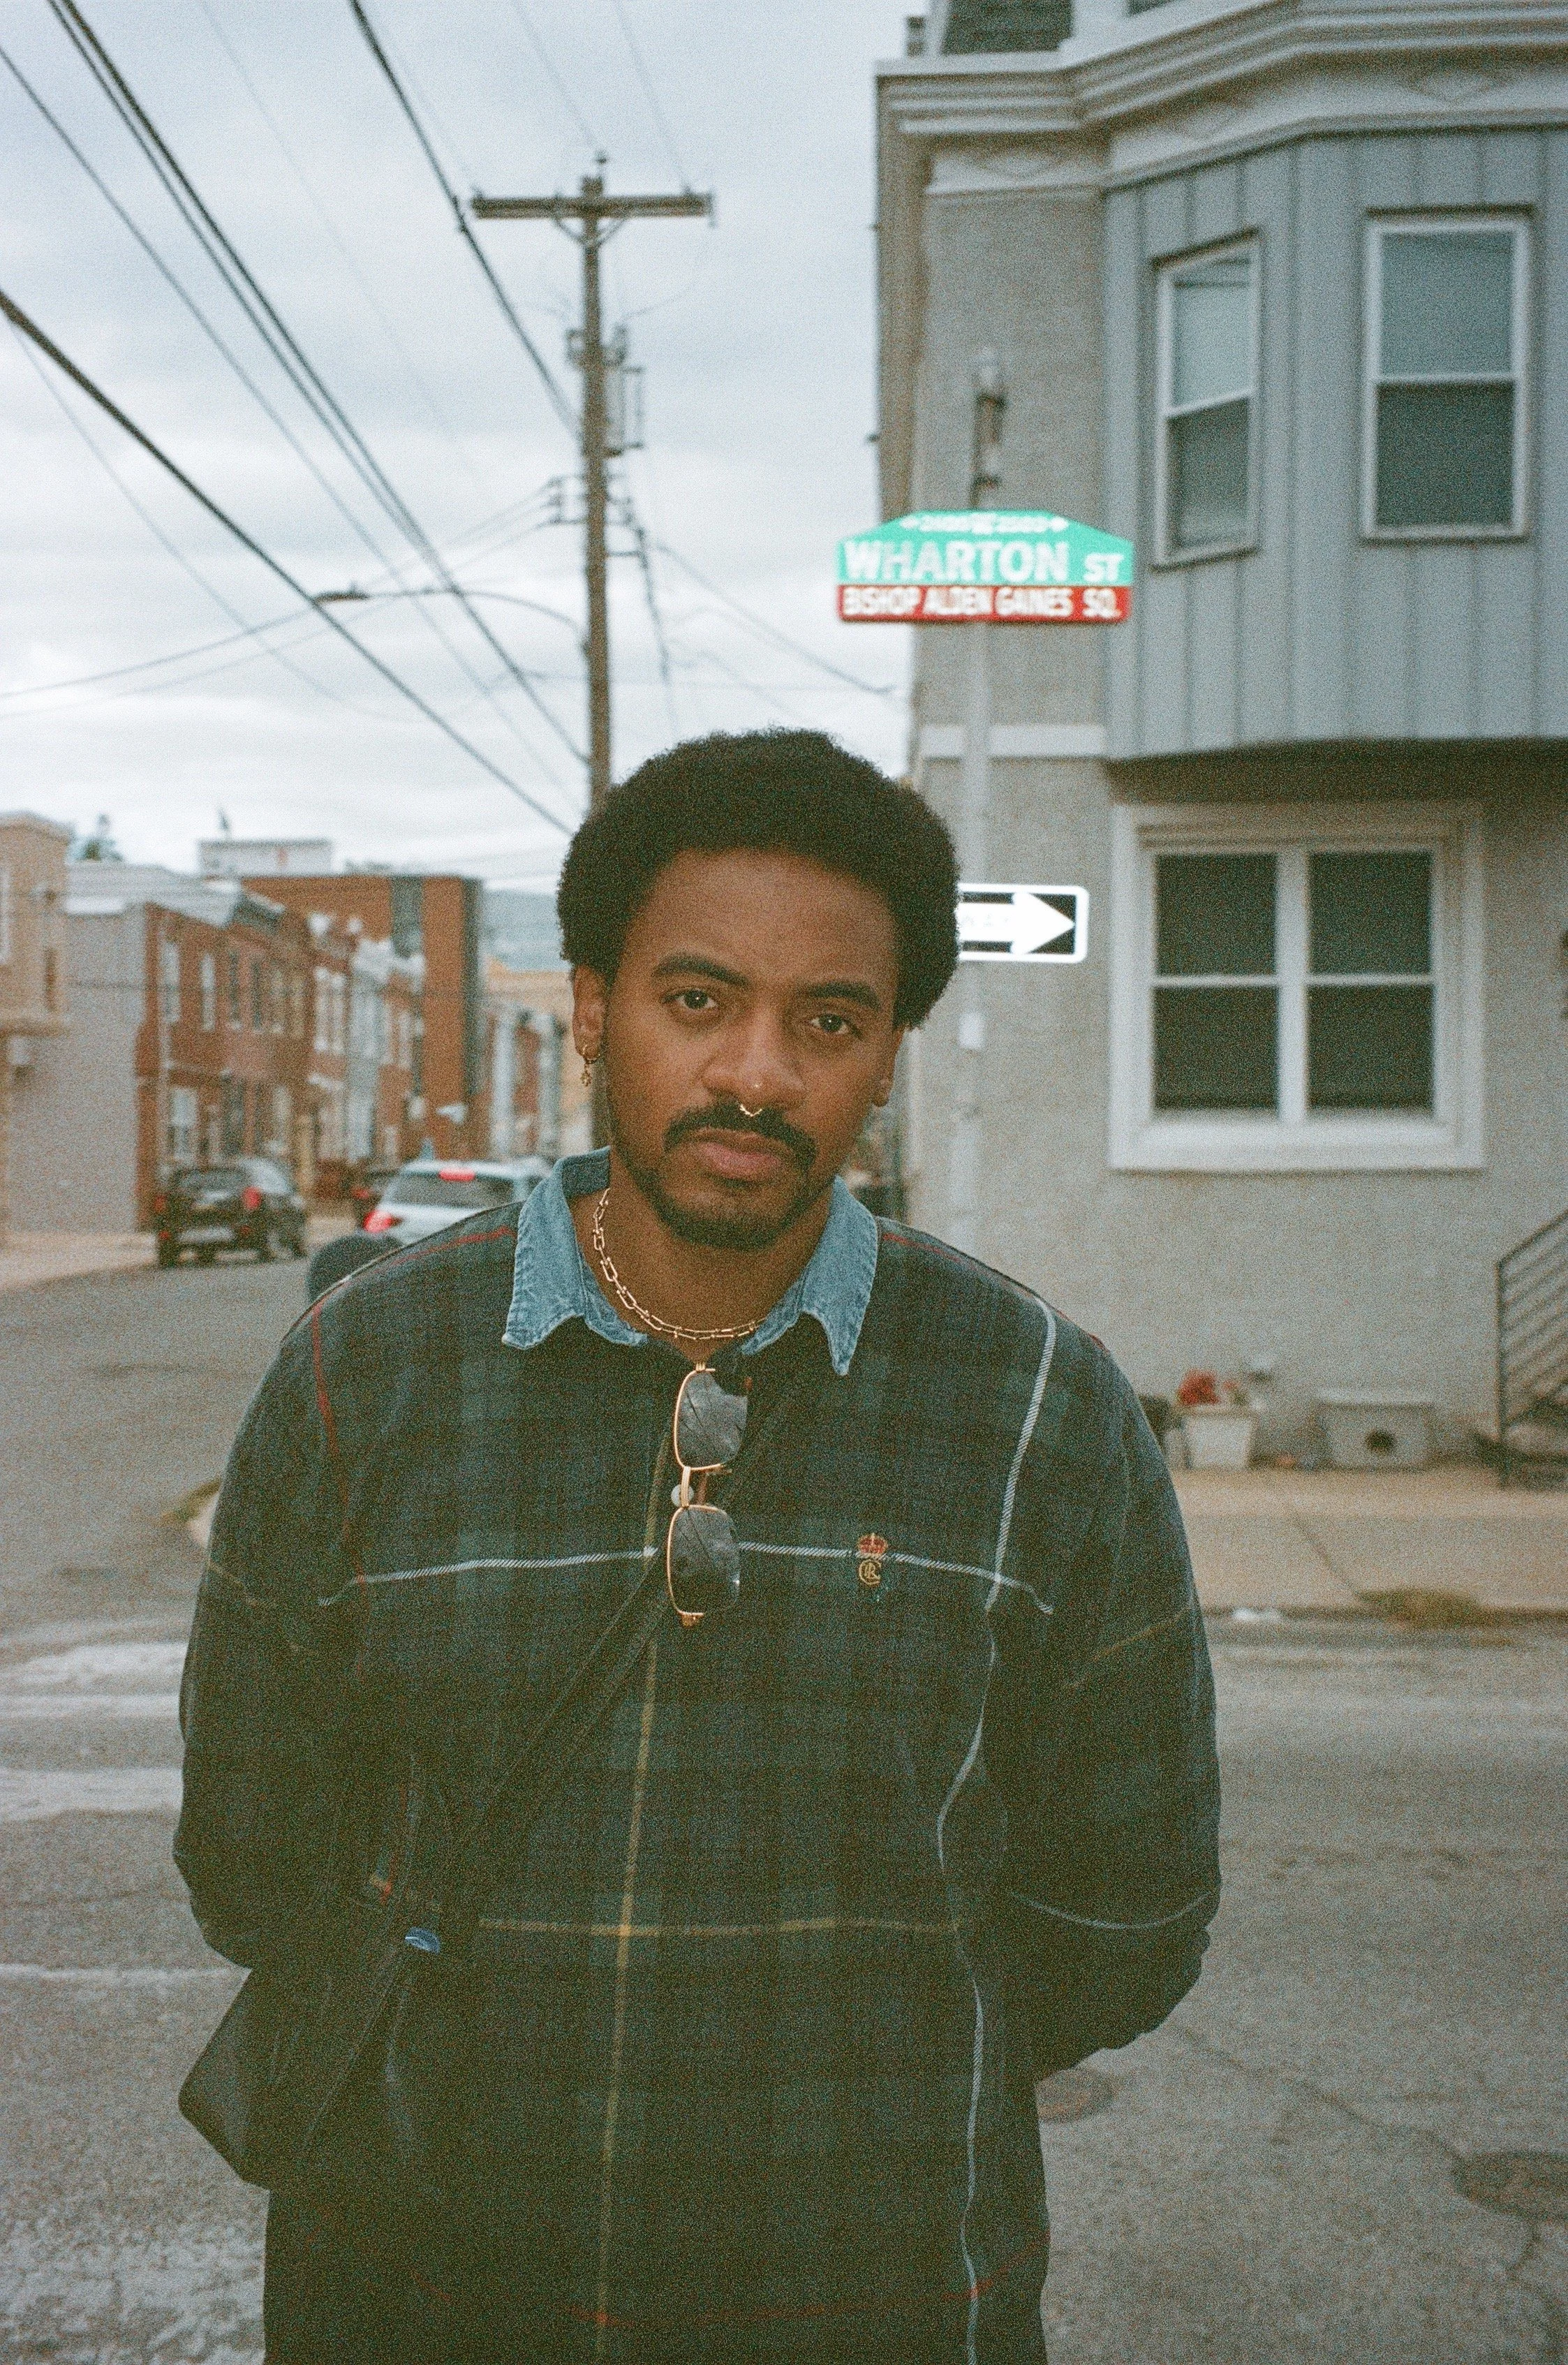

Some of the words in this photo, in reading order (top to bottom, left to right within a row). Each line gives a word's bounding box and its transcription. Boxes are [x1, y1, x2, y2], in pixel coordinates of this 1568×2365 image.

[844, 540, 1069, 581] WHARTON
[1083, 553, 1124, 582] ST
[843, 587, 921, 615] BISHOP
[996, 587, 1073, 617] GAINES
